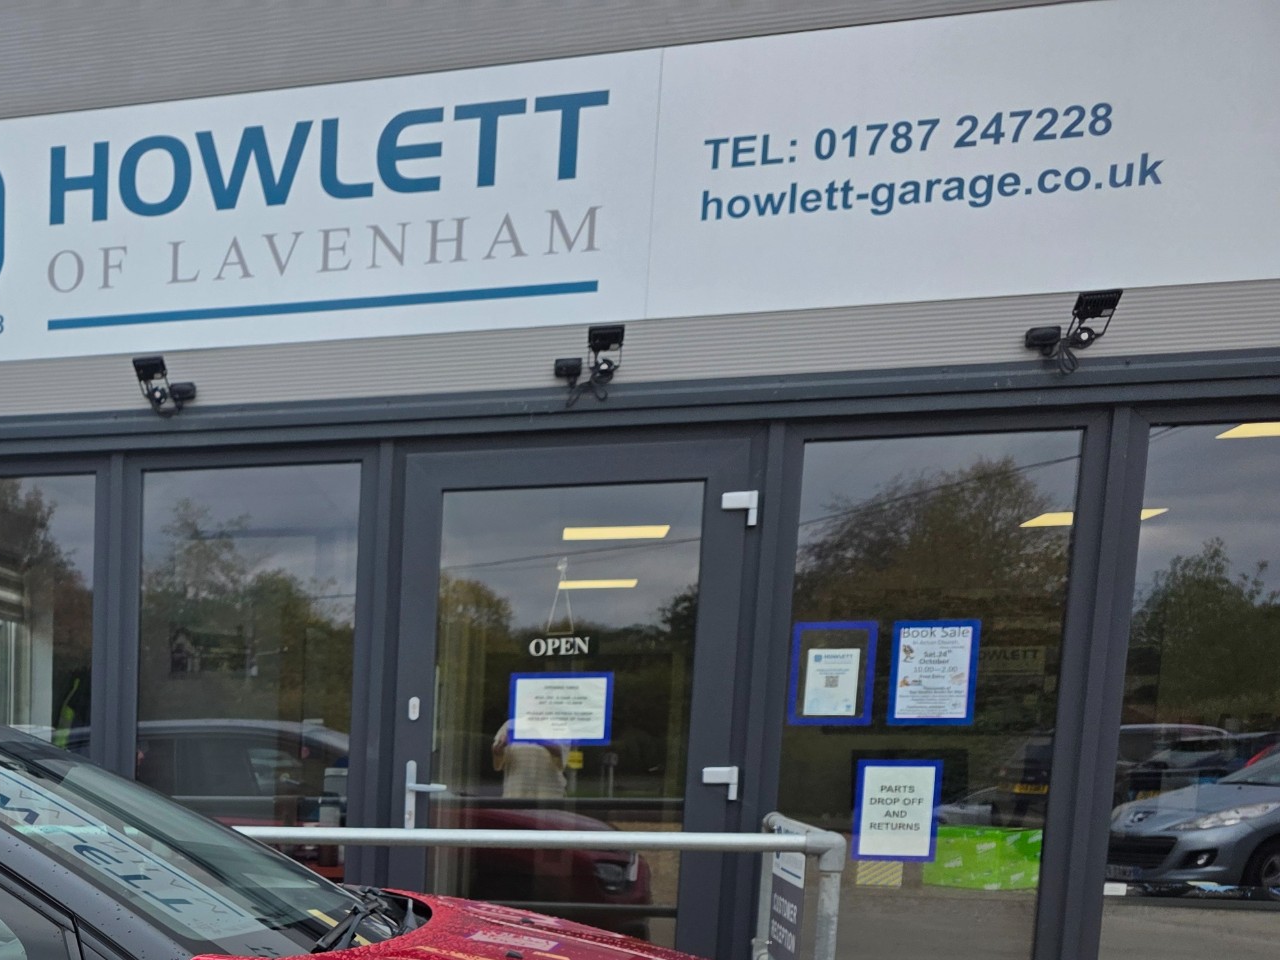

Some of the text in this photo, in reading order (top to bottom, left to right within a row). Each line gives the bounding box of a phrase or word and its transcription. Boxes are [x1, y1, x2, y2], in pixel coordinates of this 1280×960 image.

[704, 102, 1115, 170] TEL: 01787 247228
[49, 90, 610, 226] HOWLETT
[700, 152, 1165, 221] howlett-garage.co.uk
[47, 205, 605, 294] OF LAVENHAM
[902, 626, 970, 639] Book Sale
[529, 636, 590, 657] OPEN
[870, 797, 924, 806] DROP OFF
[880, 785, 915, 793] PARTS
[870, 822, 921, 831] RETURNS
[884, 810, 907, 818] AND
[773, 892, 798, 925] CUSTOMER
[771, 918, 796, 953] RECEPTION
